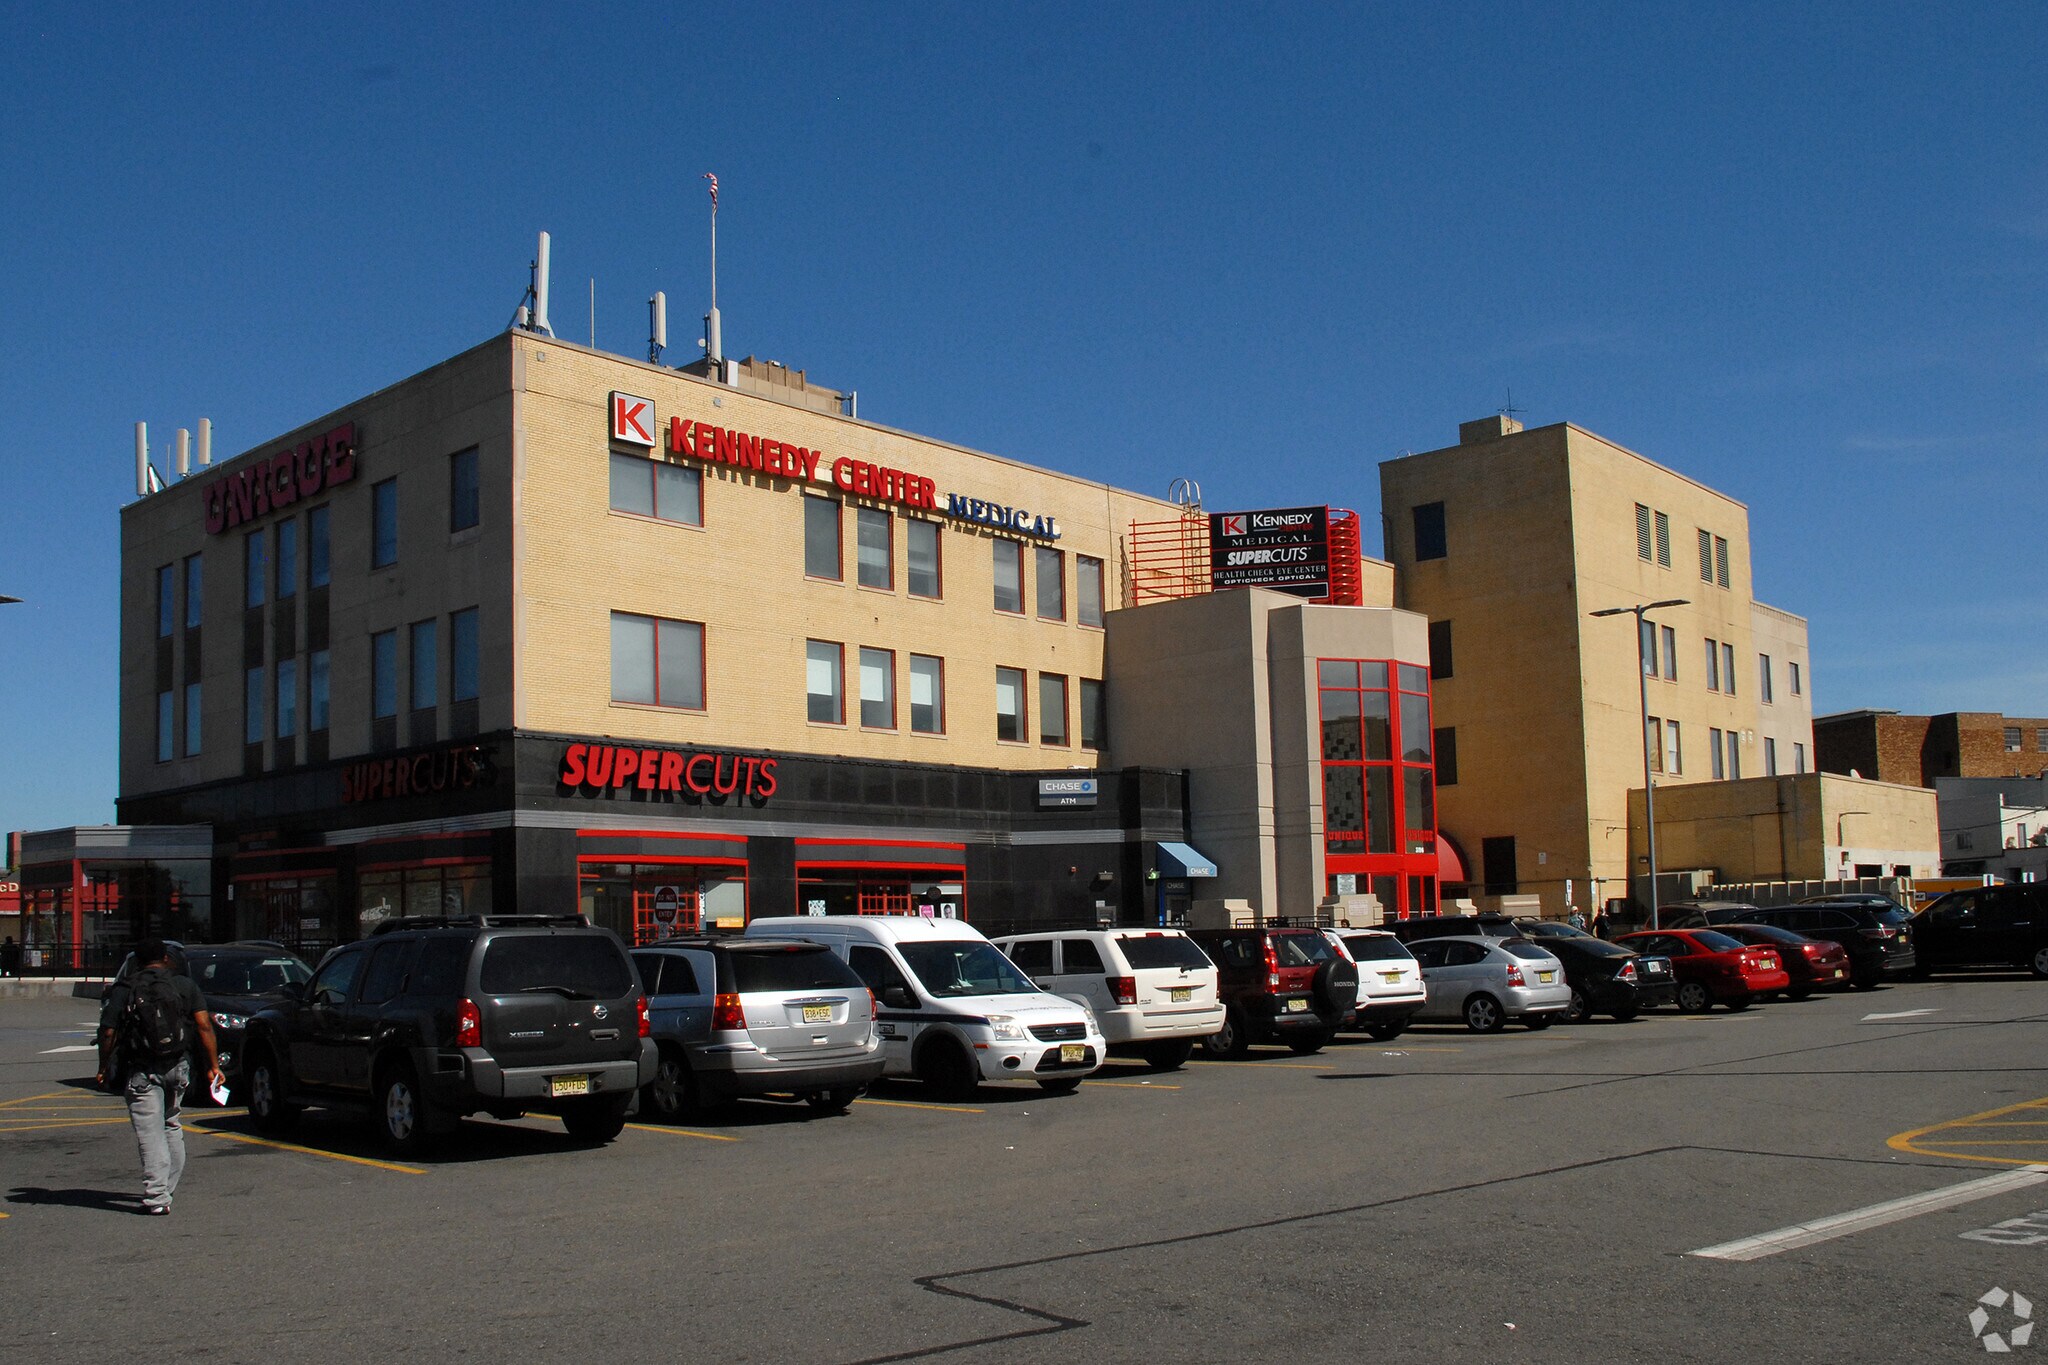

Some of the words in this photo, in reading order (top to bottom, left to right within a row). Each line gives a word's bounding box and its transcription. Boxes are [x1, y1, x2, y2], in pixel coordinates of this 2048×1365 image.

[618, 398, 652, 441] K
[671, 416, 820, 482] KENNEDY
[833, 457, 938, 510] CENTER
[203, 421, 354, 535] UNIQUE
[948, 493, 1061, 540] MEDICAL
[1224, 516, 1244, 535] K
[1253, 513, 1312, 527] KENNEDY
[1232, 534, 1312, 546] MEDICAL
[1227, 547, 1309, 566] SUPERCUTS
[1214, 569, 1245, 579] HEALTH
[1248, 568, 1274, 577] CHECK
[1277, 567, 1292, 575] EYE
[1295, 565, 1326, 574] CENTER
[1224, 576, 1274, 585] OPTICHECK
[341, 744, 478, 804] SUPERCUTS
[563, 743, 779, 797] SUPERCUTS
[1045, 782, 1080, 791] CHASE
[1060, 797, 1076, 805] ATM
[1190, 867, 1209, 875] CHASE
